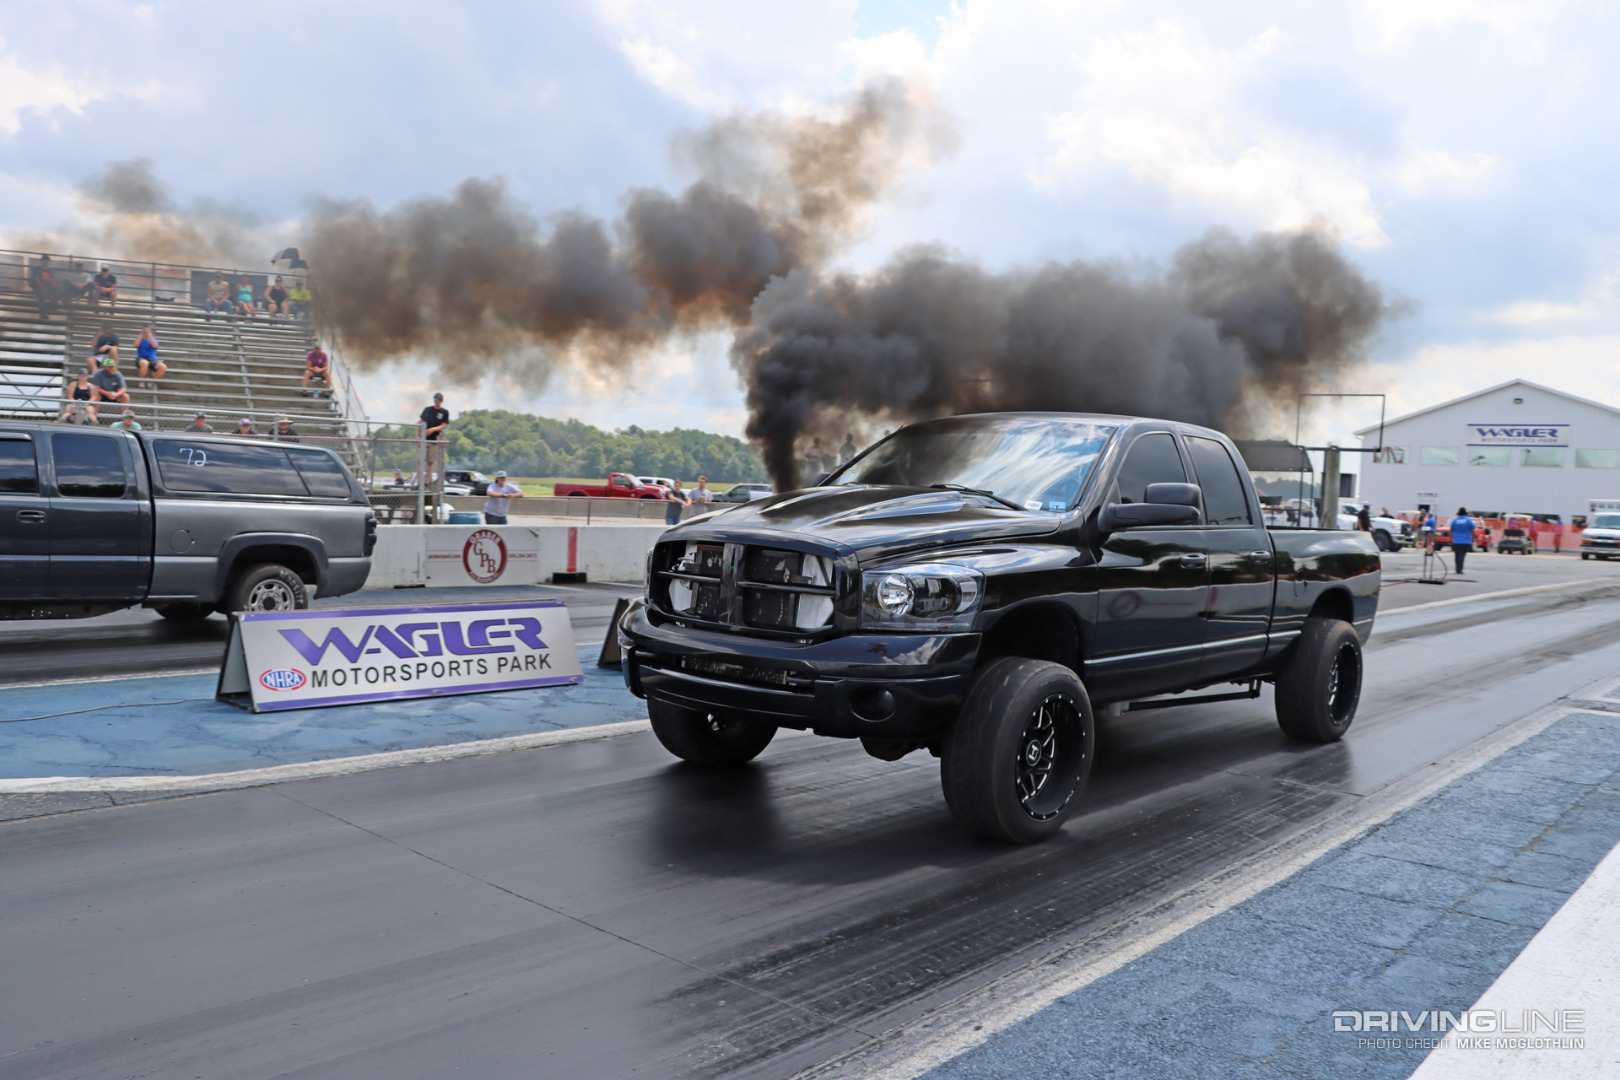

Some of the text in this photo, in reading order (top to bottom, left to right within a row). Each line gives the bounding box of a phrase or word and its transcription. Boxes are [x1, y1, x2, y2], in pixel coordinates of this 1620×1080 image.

[1476, 428, 1558, 437] WAGLER
[180, 448, 208, 467] 72
[469, 531, 501, 545] GRABER
[278, 617, 549, 666] WAGLER
[264, 670, 303, 688] NHRA
[312, 653, 552, 688] MOTORSPORTS PARK
